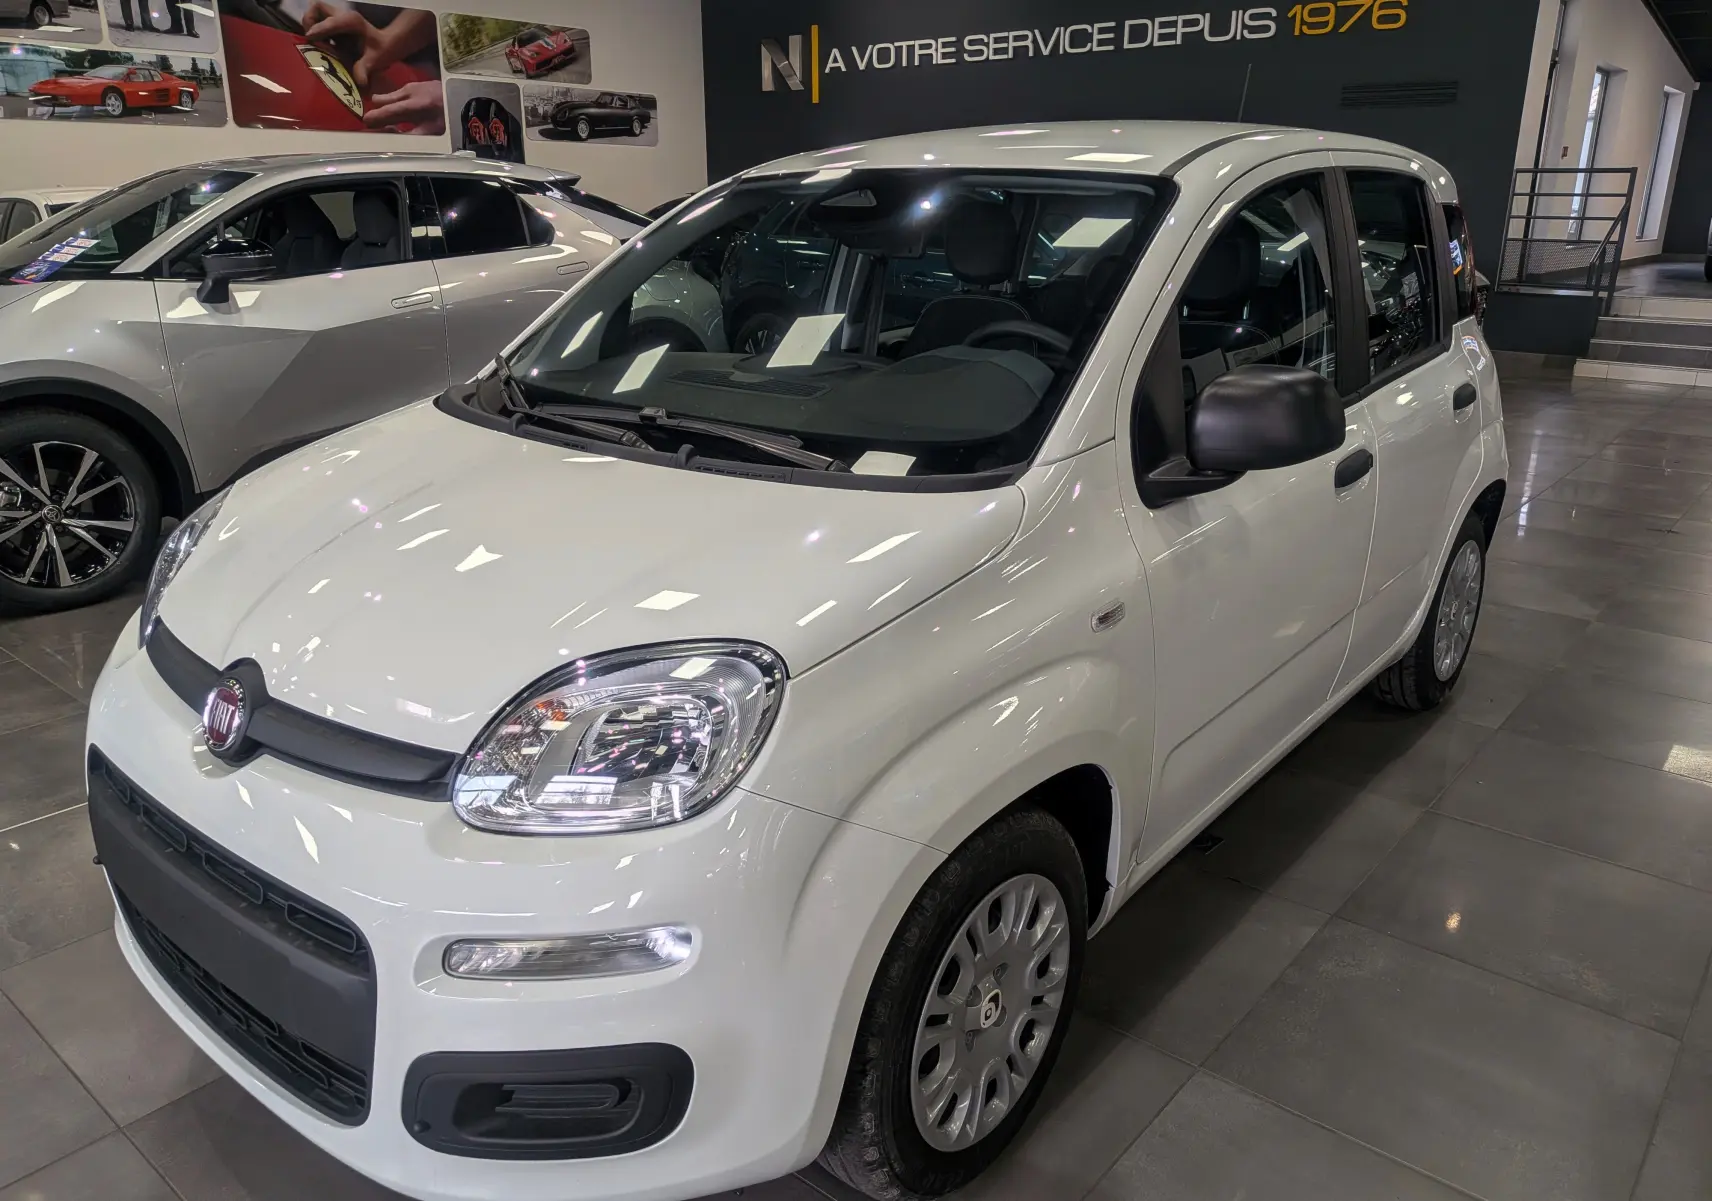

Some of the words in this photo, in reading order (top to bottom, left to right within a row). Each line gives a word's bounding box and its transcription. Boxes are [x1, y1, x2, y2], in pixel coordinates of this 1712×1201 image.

[761, 34, 804, 91] N
[824, 48, 847, 74] A
[851, 36, 957, 71] VOTRE
[963, 22, 1116, 62] SERVICE
[1123, 7, 1277, 49] DEPUIS
[1287, 0, 1407, 36] 1976
[209, 698, 235, 734] FIAT
